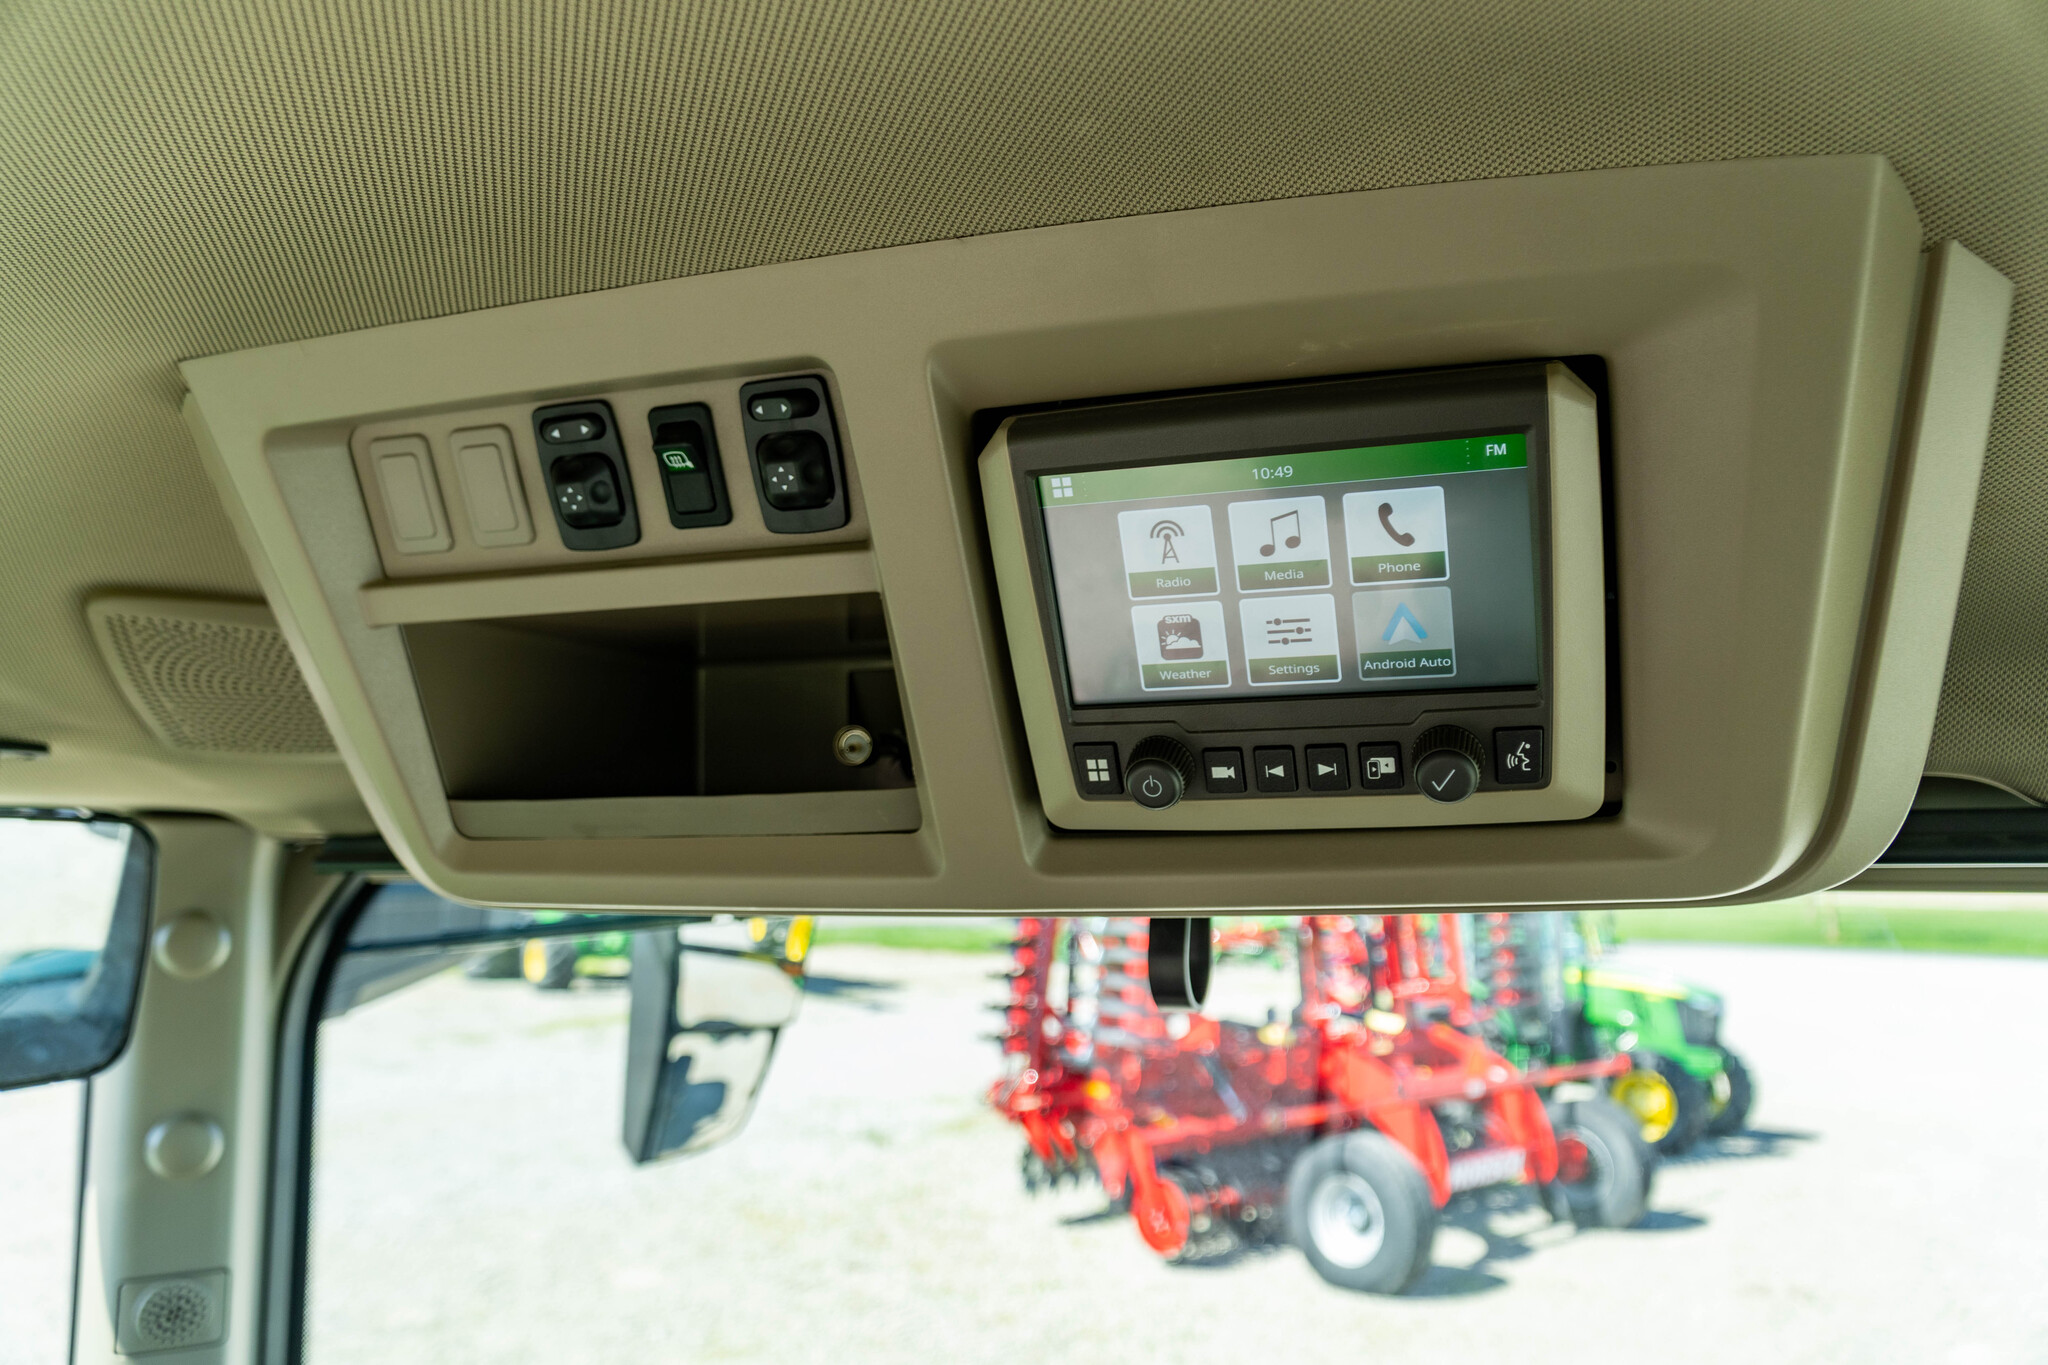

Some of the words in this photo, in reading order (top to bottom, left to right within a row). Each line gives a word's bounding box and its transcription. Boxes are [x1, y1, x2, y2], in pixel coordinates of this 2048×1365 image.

[1485, 443, 1507, 457] FM
[1251, 464, 1294, 481] 10:49
[1377, 559, 1422, 574] Phone
[1264, 567, 1305, 582] Media
[1155, 575, 1192, 590] Radio
[1164, 615, 1192, 624] sxm
[1267, 661, 1321, 678] Settings
[1363, 655, 1417, 670] Android
[1418, 654, 1452, 669] Auto
[1159, 668, 1212, 681] Weather
